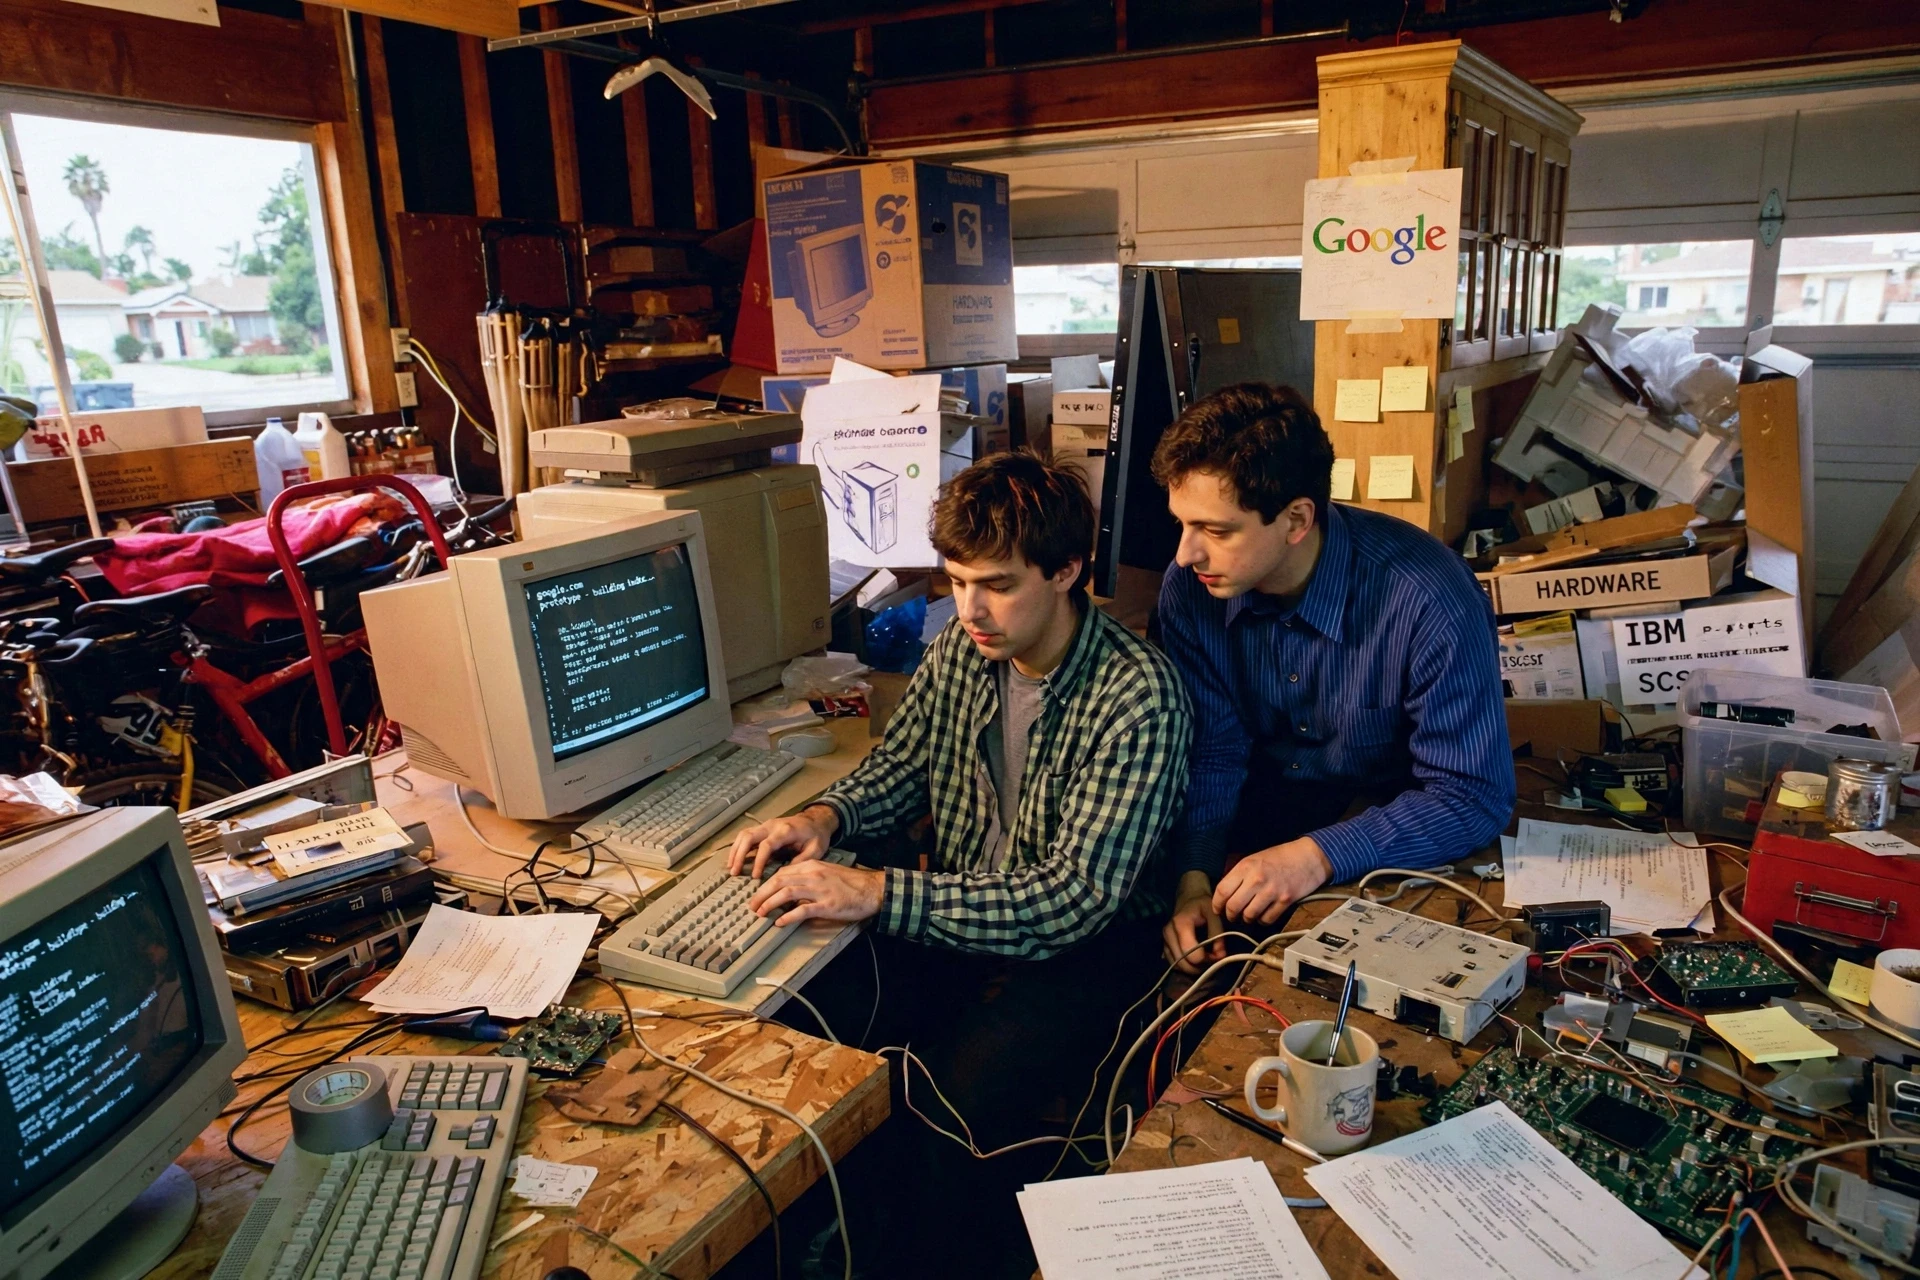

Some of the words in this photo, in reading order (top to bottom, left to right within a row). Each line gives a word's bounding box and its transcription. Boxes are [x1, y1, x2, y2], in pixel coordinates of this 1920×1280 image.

[1312, 213, 1448, 266] Google
[536, 581, 585, 601] google.com
[1536, 570, 1661, 600] HARDWARE
[539, 593, 582, 613] prototype
[1625, 618, 1686, 647] IBM
